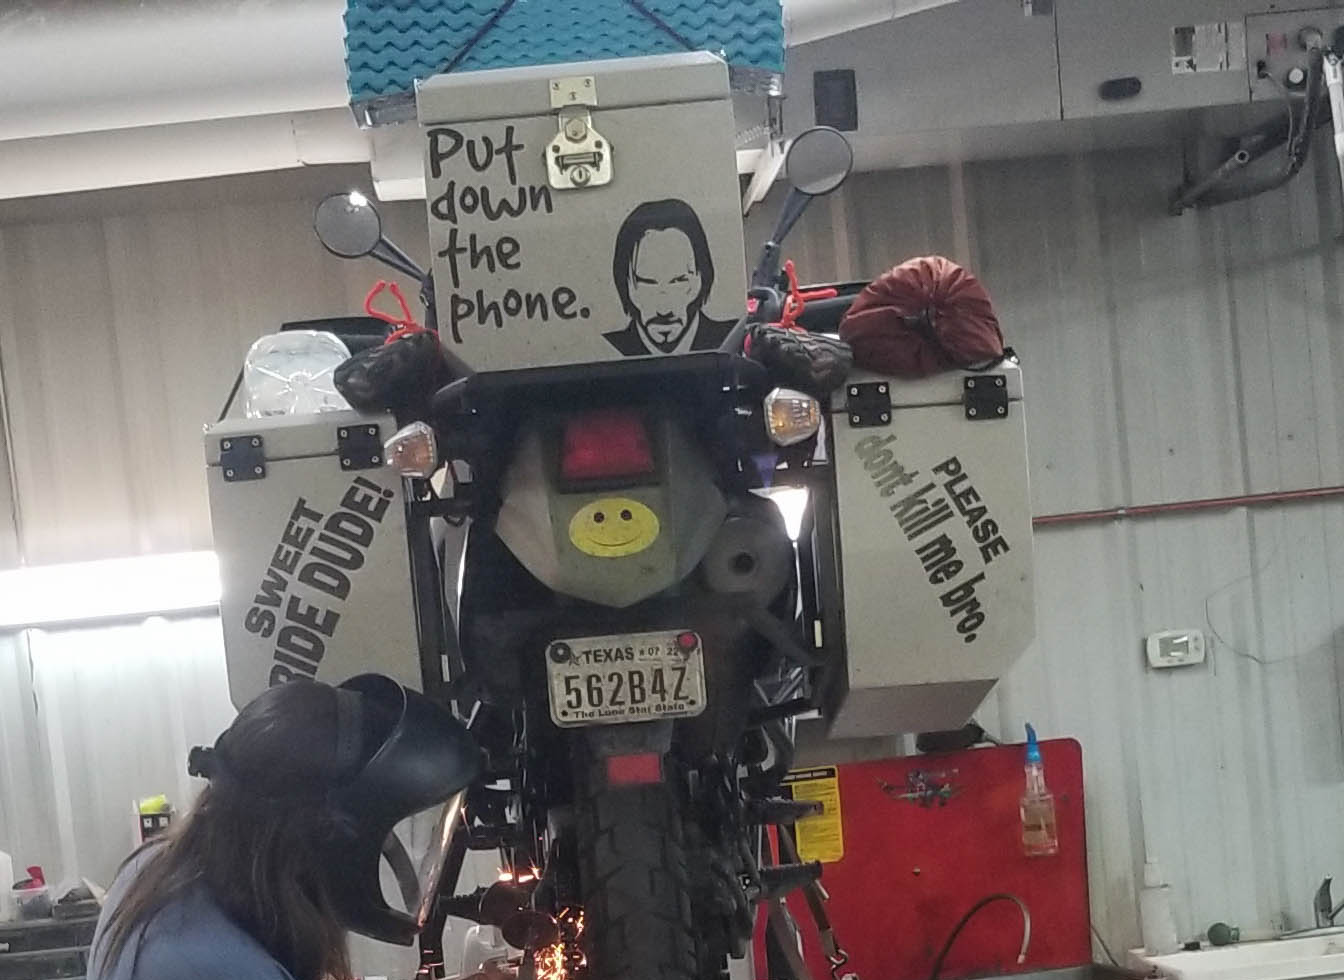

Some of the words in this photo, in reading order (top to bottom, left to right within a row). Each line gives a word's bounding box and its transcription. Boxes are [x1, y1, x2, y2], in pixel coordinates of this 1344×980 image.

[427, 125, 524, 185] Put
[430, 181, 553, 224] down
[438, 227, 521, 288] the
[450, 286, 590, 344] phone.
[297, 475, 395, 602] DUDE!
[889, 481, 955, 542] kill
[932, 456, 1010, 565] PLEASE
[244, 496, 325, 639] SWEET
[914, 533, 964, 585] me
[938, 571, 986, 644] bro.
[582, 646, 635, 665] TEXAS
[564, 666, 689, 709] 562B4Z
[575, 710, 595, 719] The
